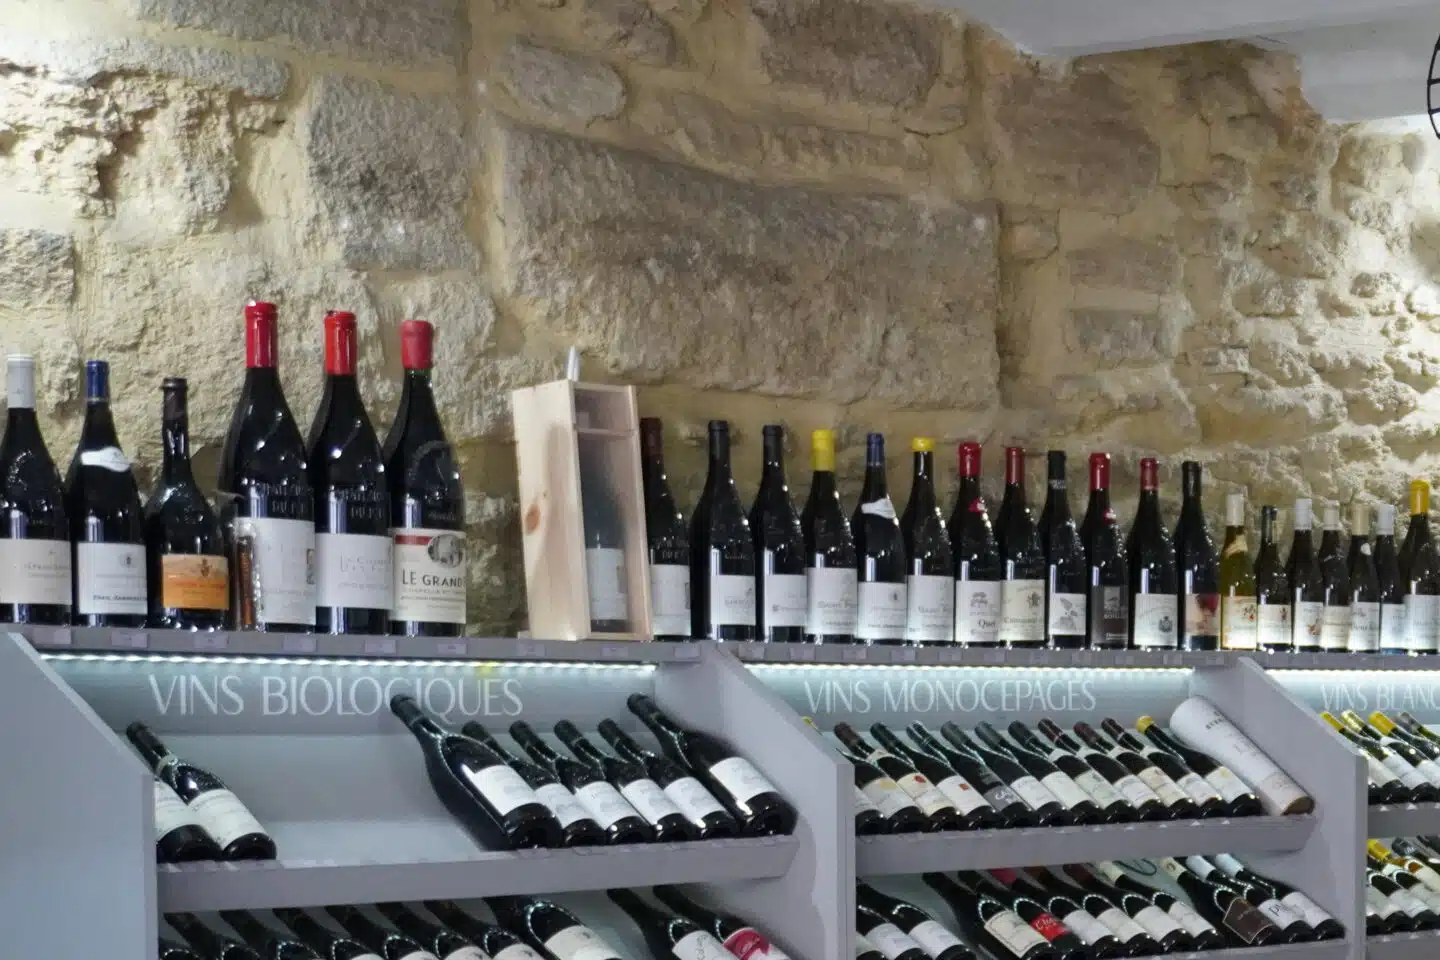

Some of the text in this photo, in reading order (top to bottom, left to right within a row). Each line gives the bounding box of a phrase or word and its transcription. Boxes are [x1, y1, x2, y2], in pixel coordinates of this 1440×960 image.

[402, 568, 463, 587] LE GRAND
[149, 674, 524, 725] VINS BIOLOGIQUES
[804, 679, 1097, 713] VINS MONOCEPAGES
[1321, 684, 1368, 711] VINS
